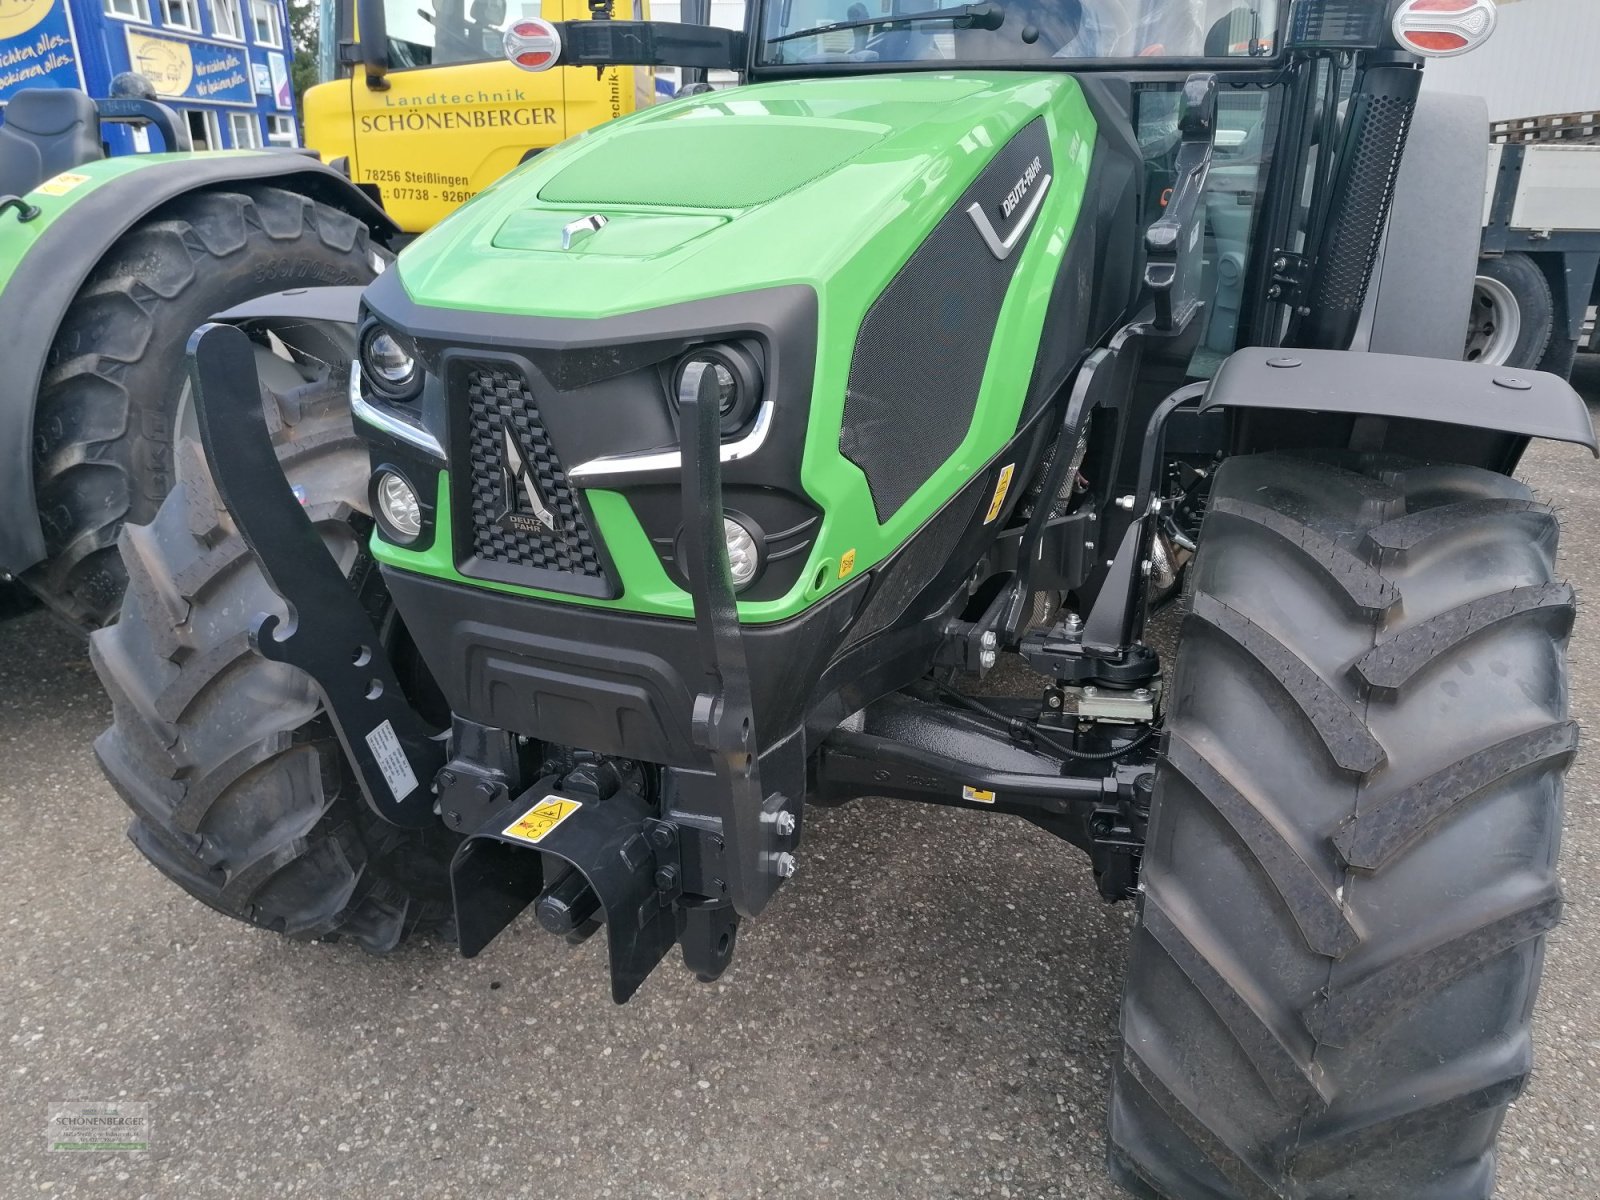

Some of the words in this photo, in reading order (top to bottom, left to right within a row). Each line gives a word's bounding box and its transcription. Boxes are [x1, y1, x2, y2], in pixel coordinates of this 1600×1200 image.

[385, 88, 526, 107] Landtechnik
[361, 107, 557, 133] SCHÖNENBERGER
[365, 168, 401, 182] 78256
[405, 171, 469, 188] Steißlingen
[1002, 155, 1042, 218] DEUTZ-FAHR
[393, 187, 430, 201] 07738
[510, 515, 543, 527] DEUTZ
[514, 522, 541, 533] FAHR
